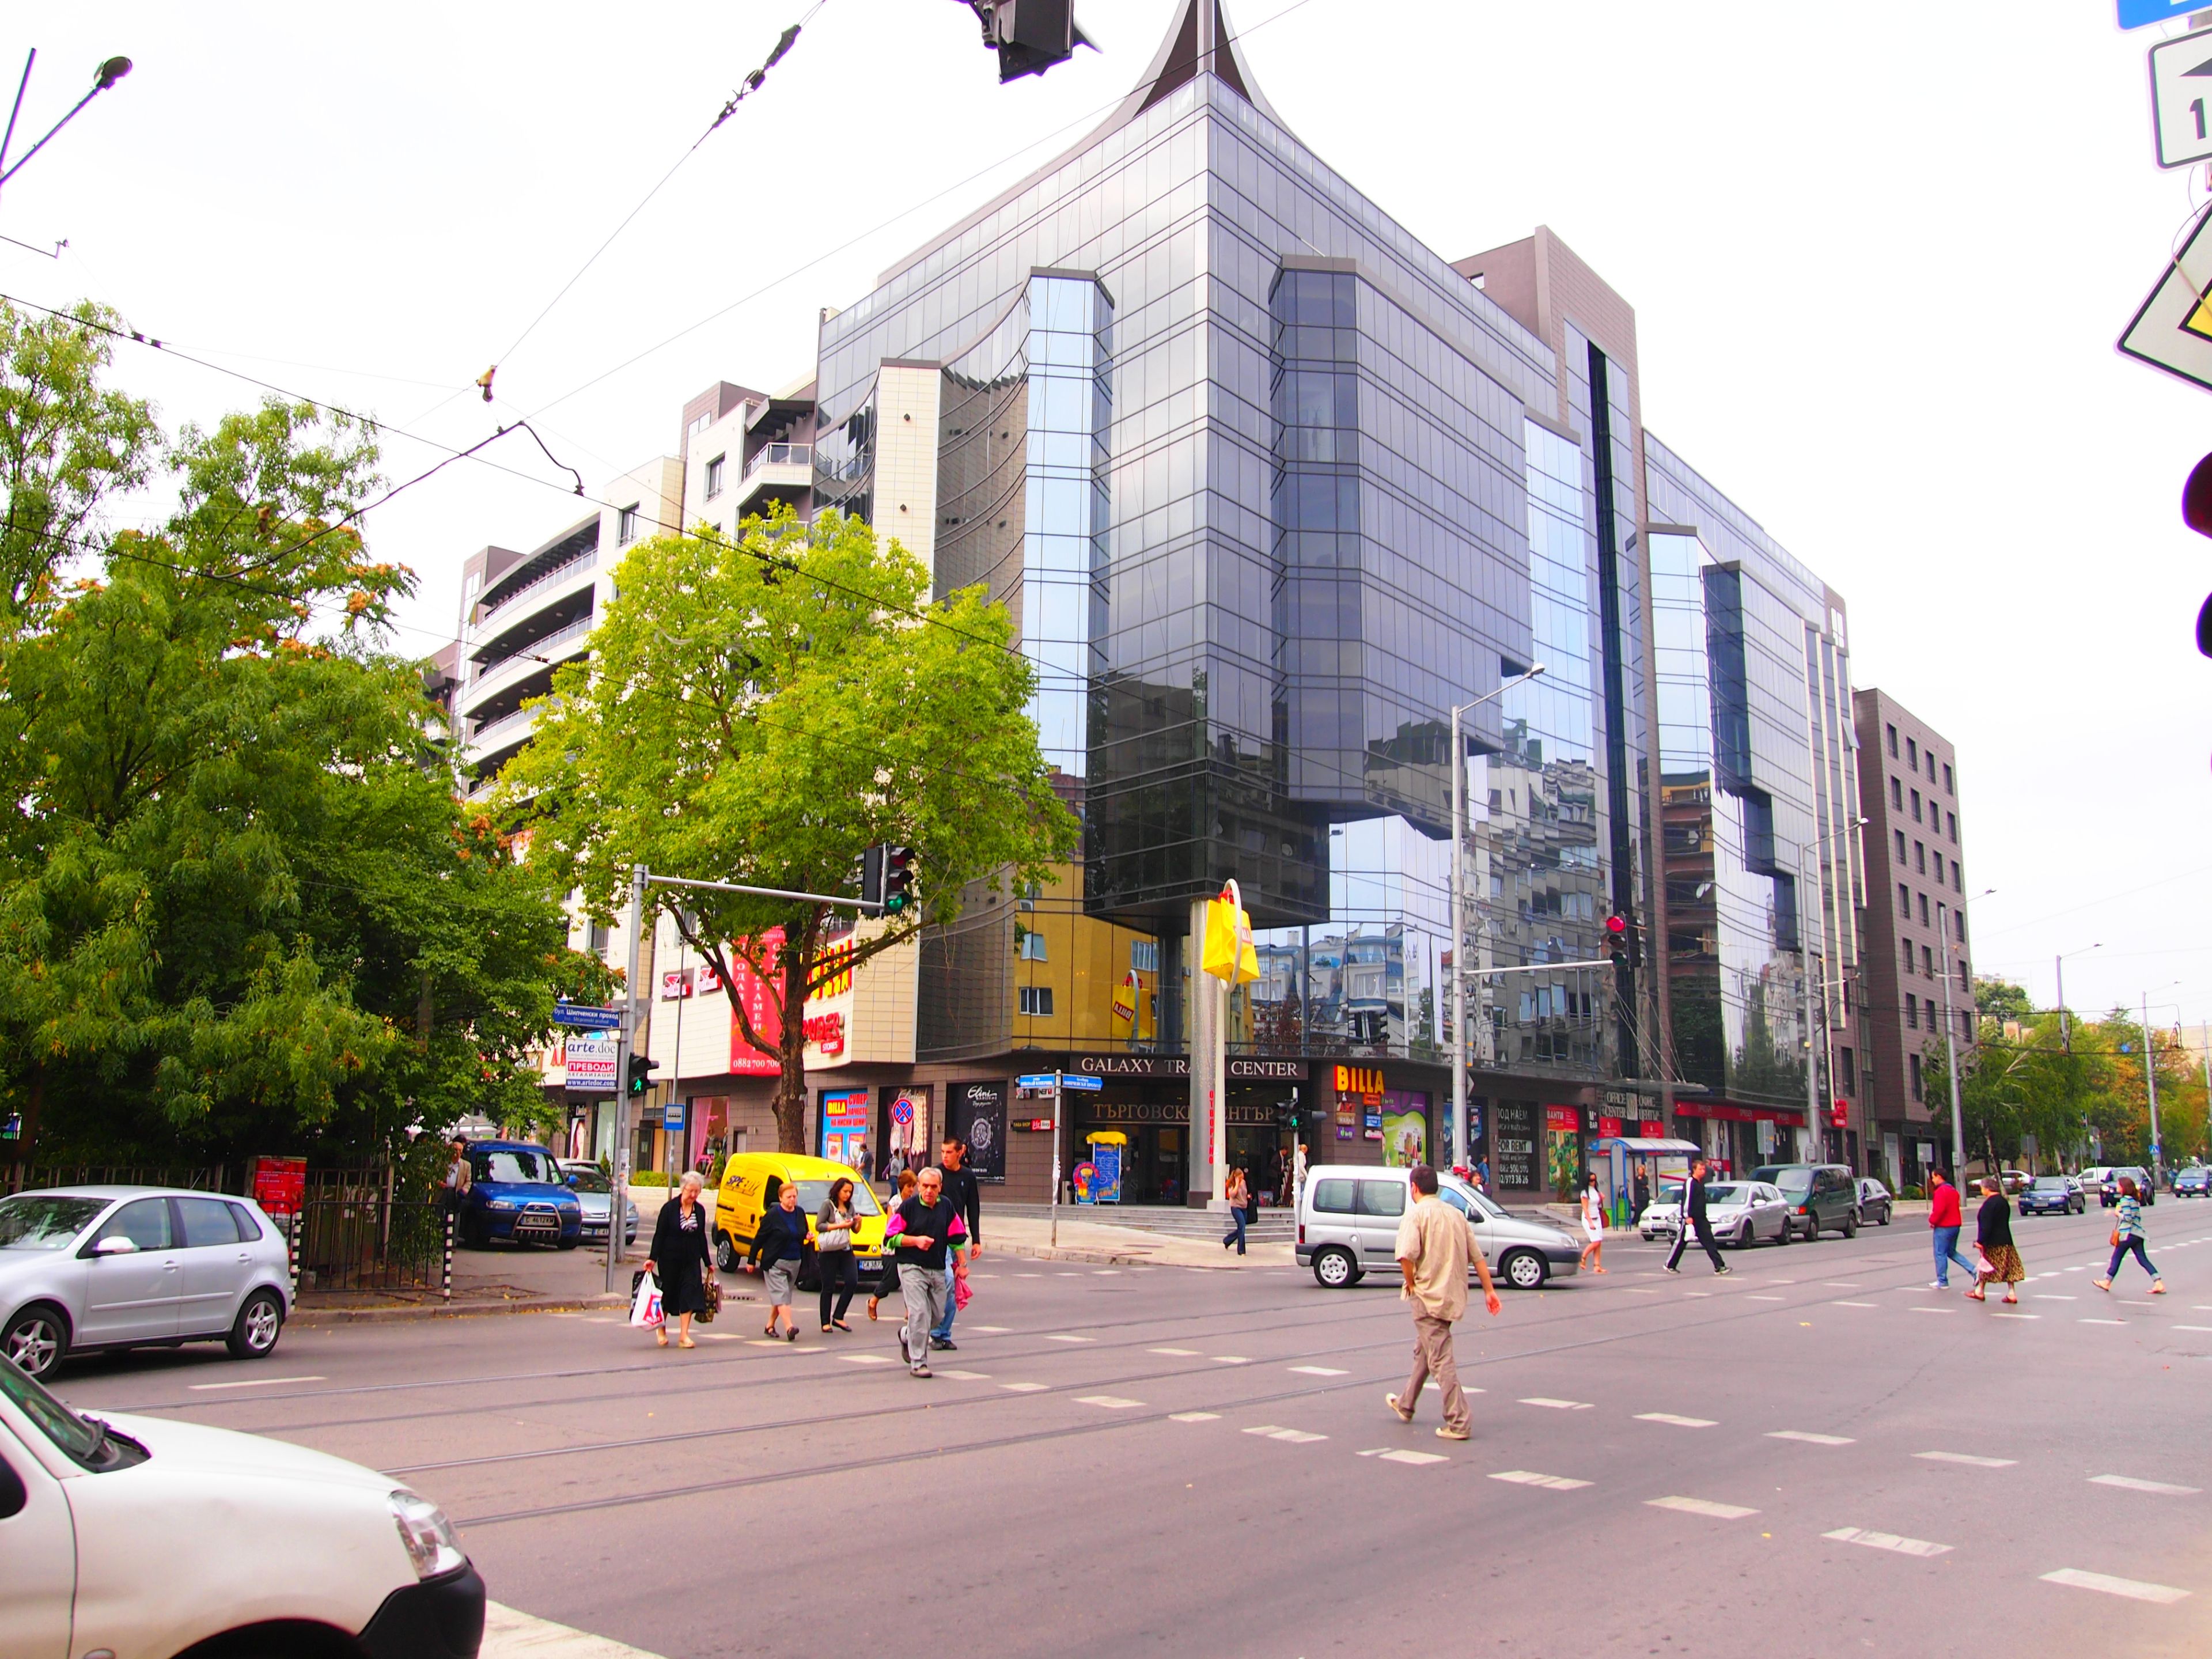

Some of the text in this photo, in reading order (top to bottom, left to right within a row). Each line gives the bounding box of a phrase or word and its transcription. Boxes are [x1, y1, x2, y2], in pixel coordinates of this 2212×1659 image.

[566, 1009, 598, 1017] Шипченски
[568, 1042, 616, 1054] arte.doc
[823, 1041, 839, 1051] STORES
[569, 1062, 614, 1071] ПРЕВОДИ
[733, 1058, 751, 1067] 0882
[1081, 1058, 1154, 1072] GALAXY
[1231, 1060, 1298, 1075] CENTER
[1336, 1065, 1385, 1094] BILLA
[827, 1101, 846, 1114] BILLA
[1512, 1141, 1527, 1152] RENT
